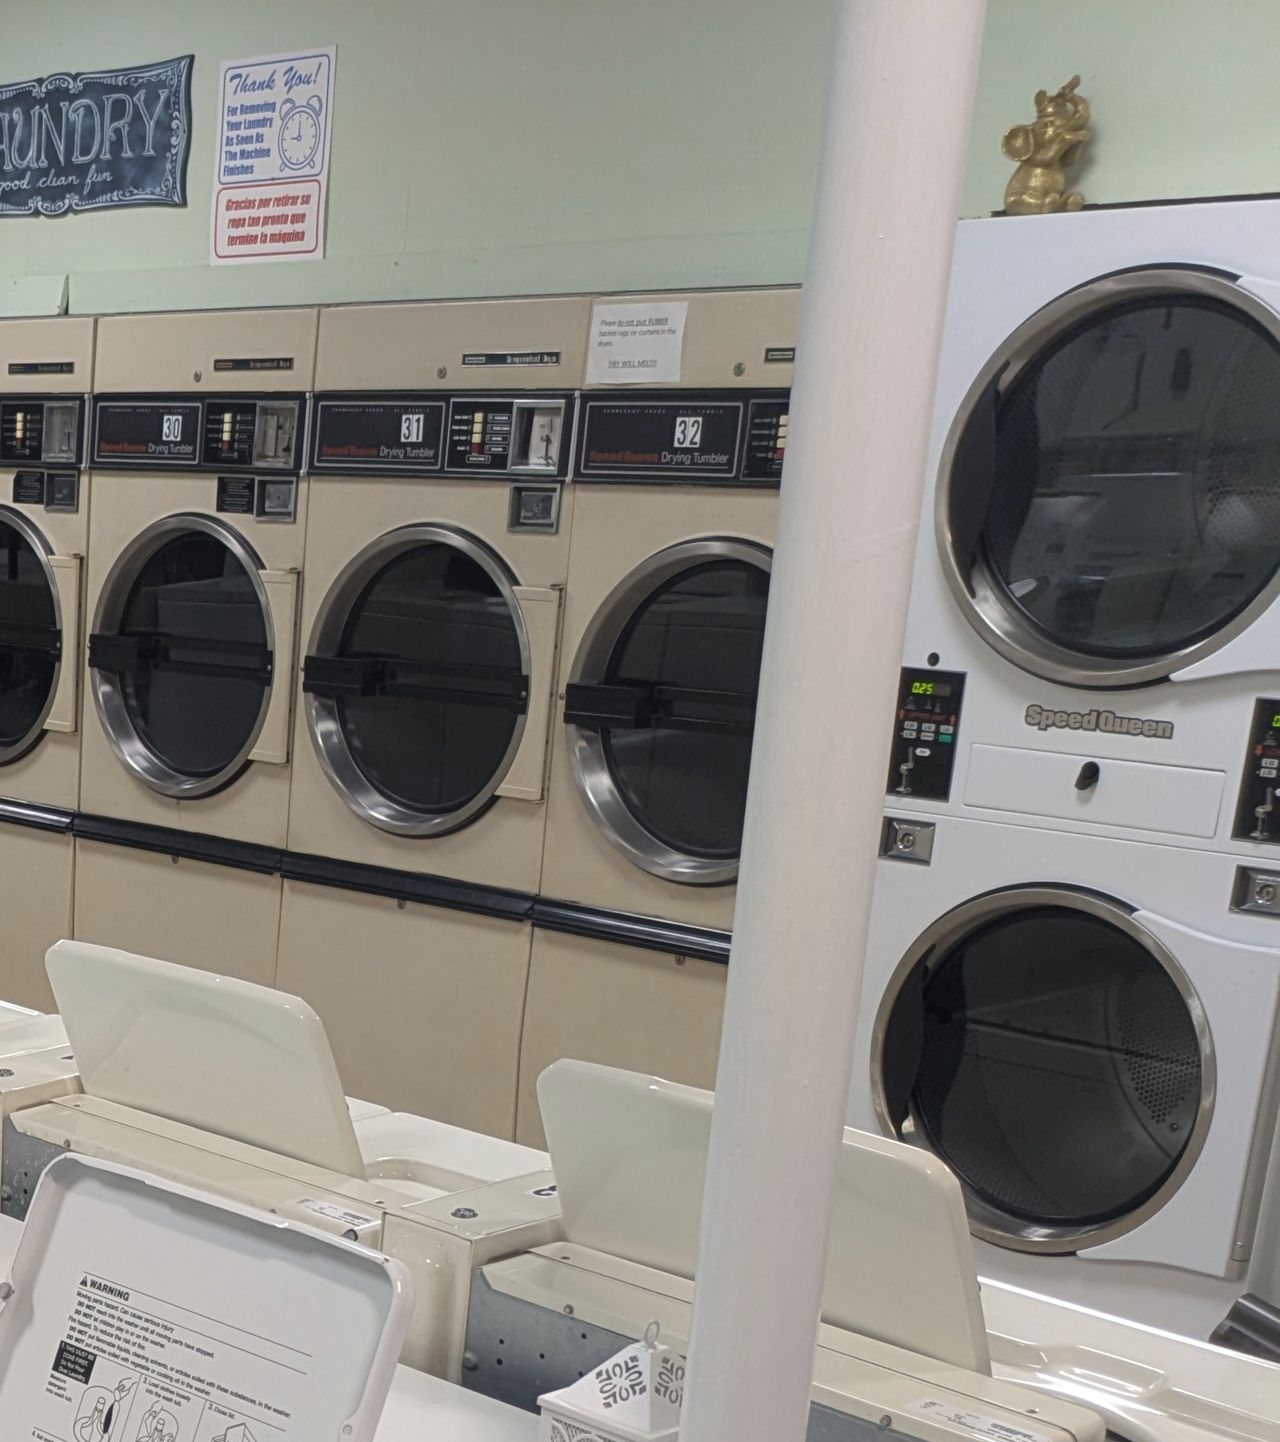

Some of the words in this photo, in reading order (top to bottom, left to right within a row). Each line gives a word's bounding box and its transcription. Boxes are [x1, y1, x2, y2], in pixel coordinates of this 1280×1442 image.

[229, 70, 277, 96] Thank
[283, 62, 322, 95] You!
[227, 106, 238, 117] For
[240, 101, 276, 115] Removing
[227, 121, 242, 132] Your
[244, 117, 273, 131] Laundry
[225, 135, 234, 147] As
[238, 133, 254, 146] Soon
[255, 132, 264, 143] As
[224, 150, 238, 162] The
[240, 146, 271, 159] Machine
[37, 168, 80, 188] clean
[83, 164, 113, 194] fun
[223, 164, 254, 177] Finishes
[225, 198, 255, 212] Gracias
[257, 197, 272, 211] por
[273, 194, 298, 207] retirar
[300, 193, 311, 205] su
[227, 215, 246, 230] ropa
[248, 214, 260, 227] tan
[262, 213, 289, 228] pronto
[290, 213, 306, 226] que
[227, 232, 258, 247] termine
[260, 232, 267, 244] la
[269, 229, 305, 245] máquina
[164, 417, 181, 439] 30
[403, 417, 423, 441] 31
[677, 419, 701, 446] 32
[148, 443, 168, 455] Drying
[170, 444, 193, 453] Tumbler
[379, 446, 404, 459] Drying
[406, 446, 434, 458] Tumbler
[661, 451, 691, 464] Drying
[693, 452, 729, 463] Tumbler
[88, 1279, 130, 1301] WARNING
